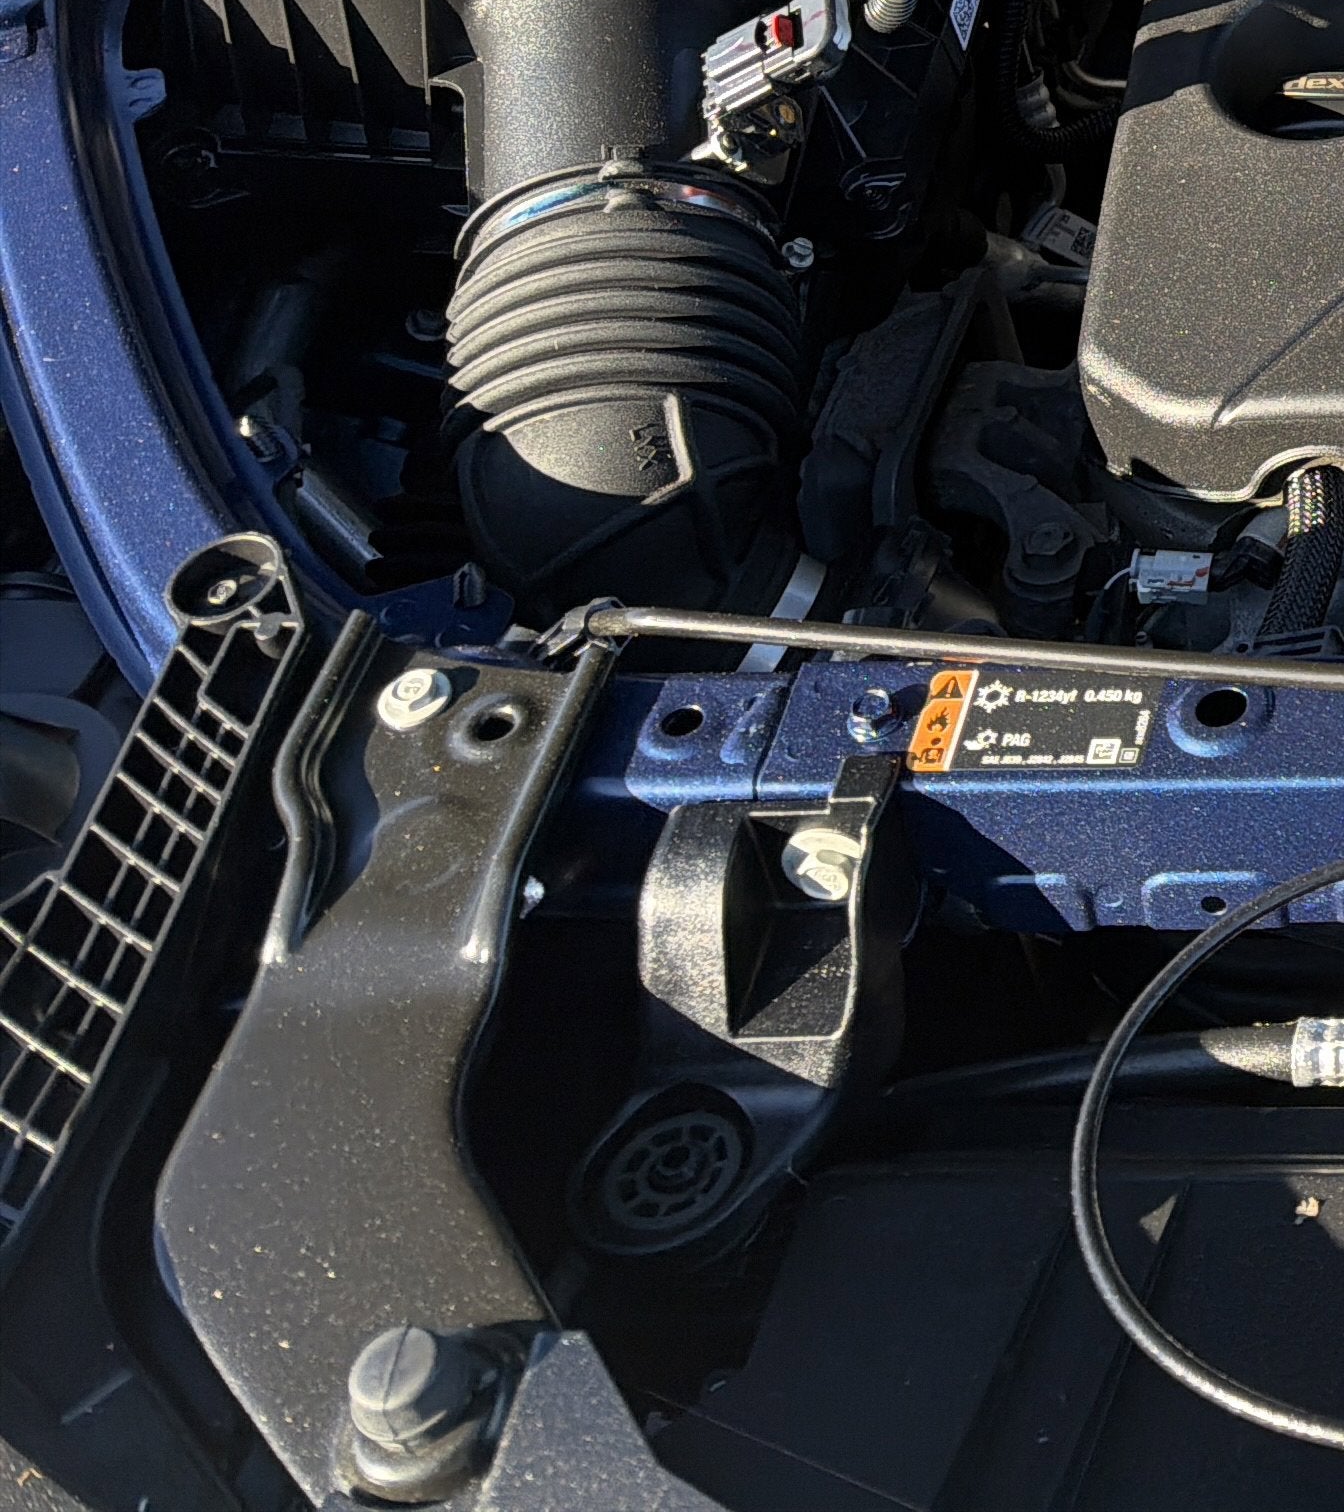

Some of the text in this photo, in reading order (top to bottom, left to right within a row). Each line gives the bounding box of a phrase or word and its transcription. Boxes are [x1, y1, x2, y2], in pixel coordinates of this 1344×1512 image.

[1083, 689, 1123, 703] 0.450
[1124, 688, 1143, 704] kg
[1001, 733, 1032, 748] PAG
